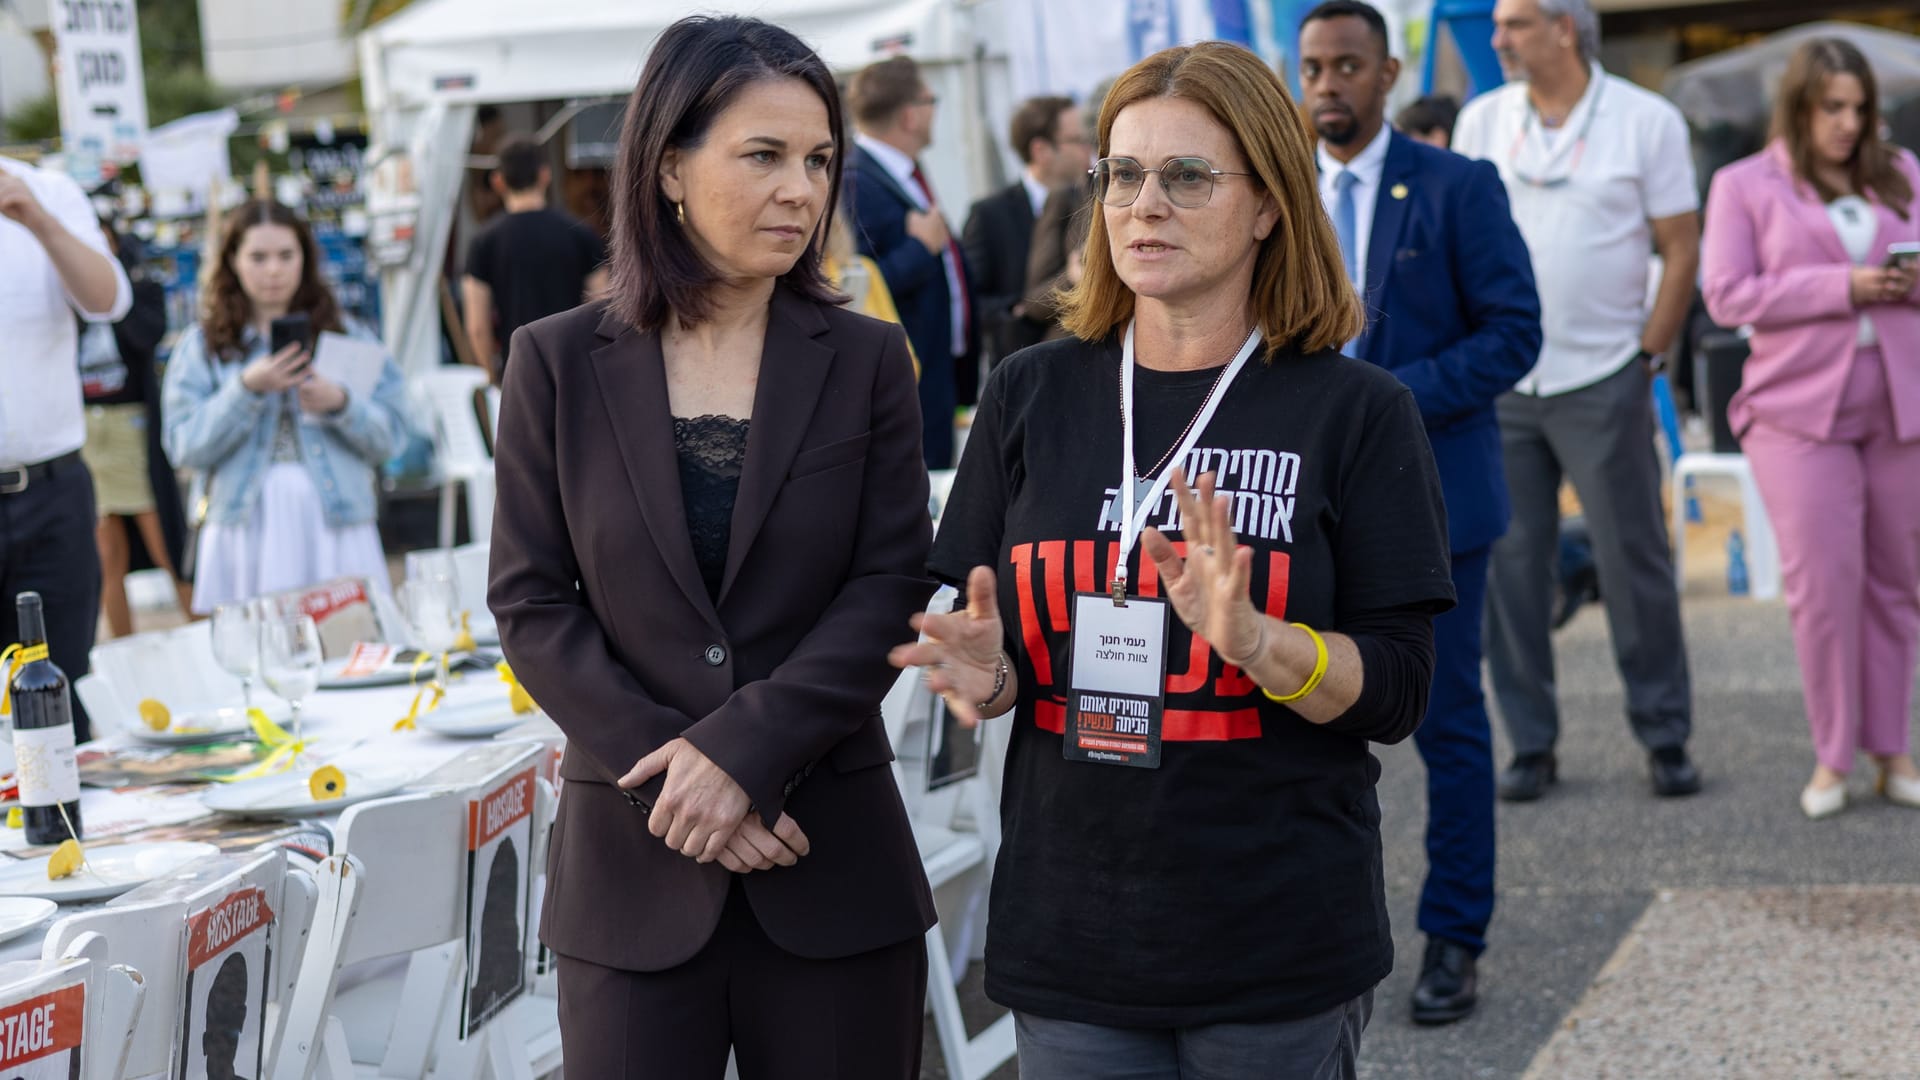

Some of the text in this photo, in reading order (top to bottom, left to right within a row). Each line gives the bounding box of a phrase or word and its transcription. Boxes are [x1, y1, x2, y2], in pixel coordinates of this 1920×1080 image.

[1099, 634, 1146, 648] נעמי חנוך
[1095, 648, 1149, 664] צוות חולצה
[1079, 694, 1149, 718] מחזירים אותם
[1115, 715, 1149, 735] הביתה
[486, 778, 528, 837] HOSTAGE
[206, 893, 260, 953] HOSTAGE
